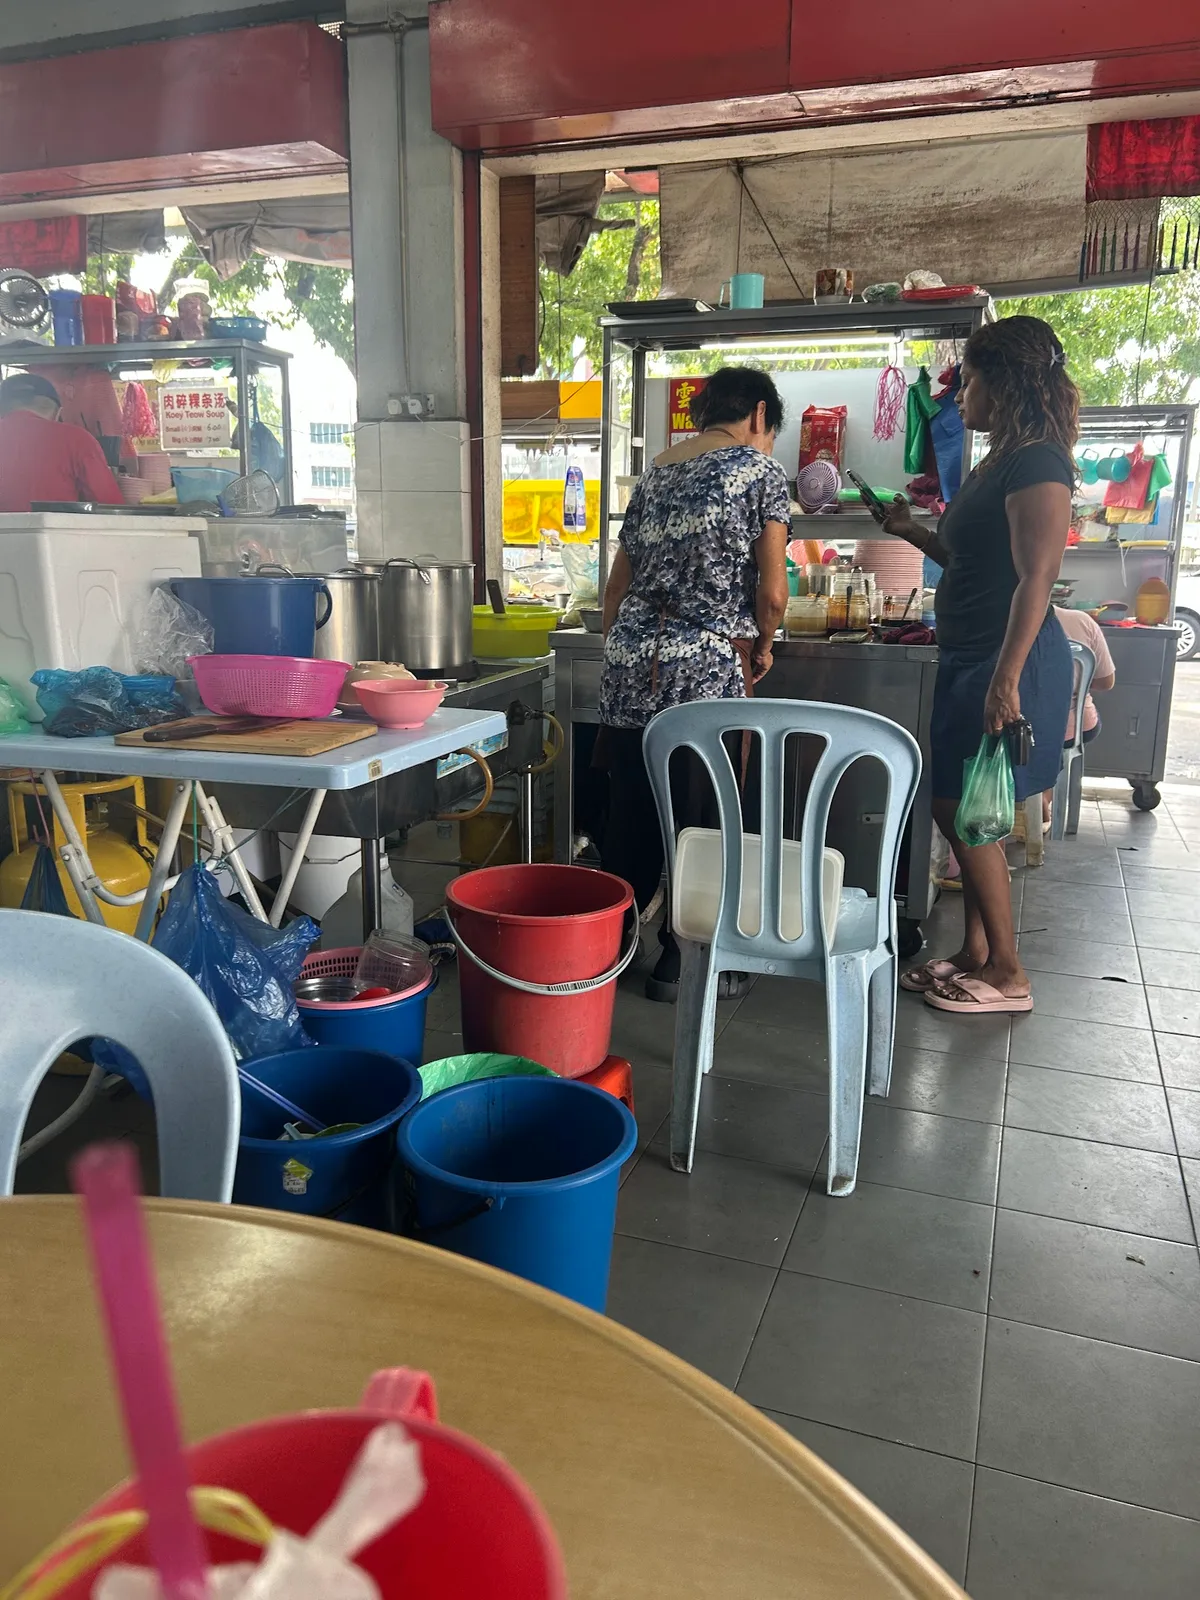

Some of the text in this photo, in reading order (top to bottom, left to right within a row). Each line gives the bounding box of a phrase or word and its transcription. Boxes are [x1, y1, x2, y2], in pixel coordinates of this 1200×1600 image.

[165, 410, 225, 420] Koey Teow Soup
[672, 413, 696, 429] Wa
